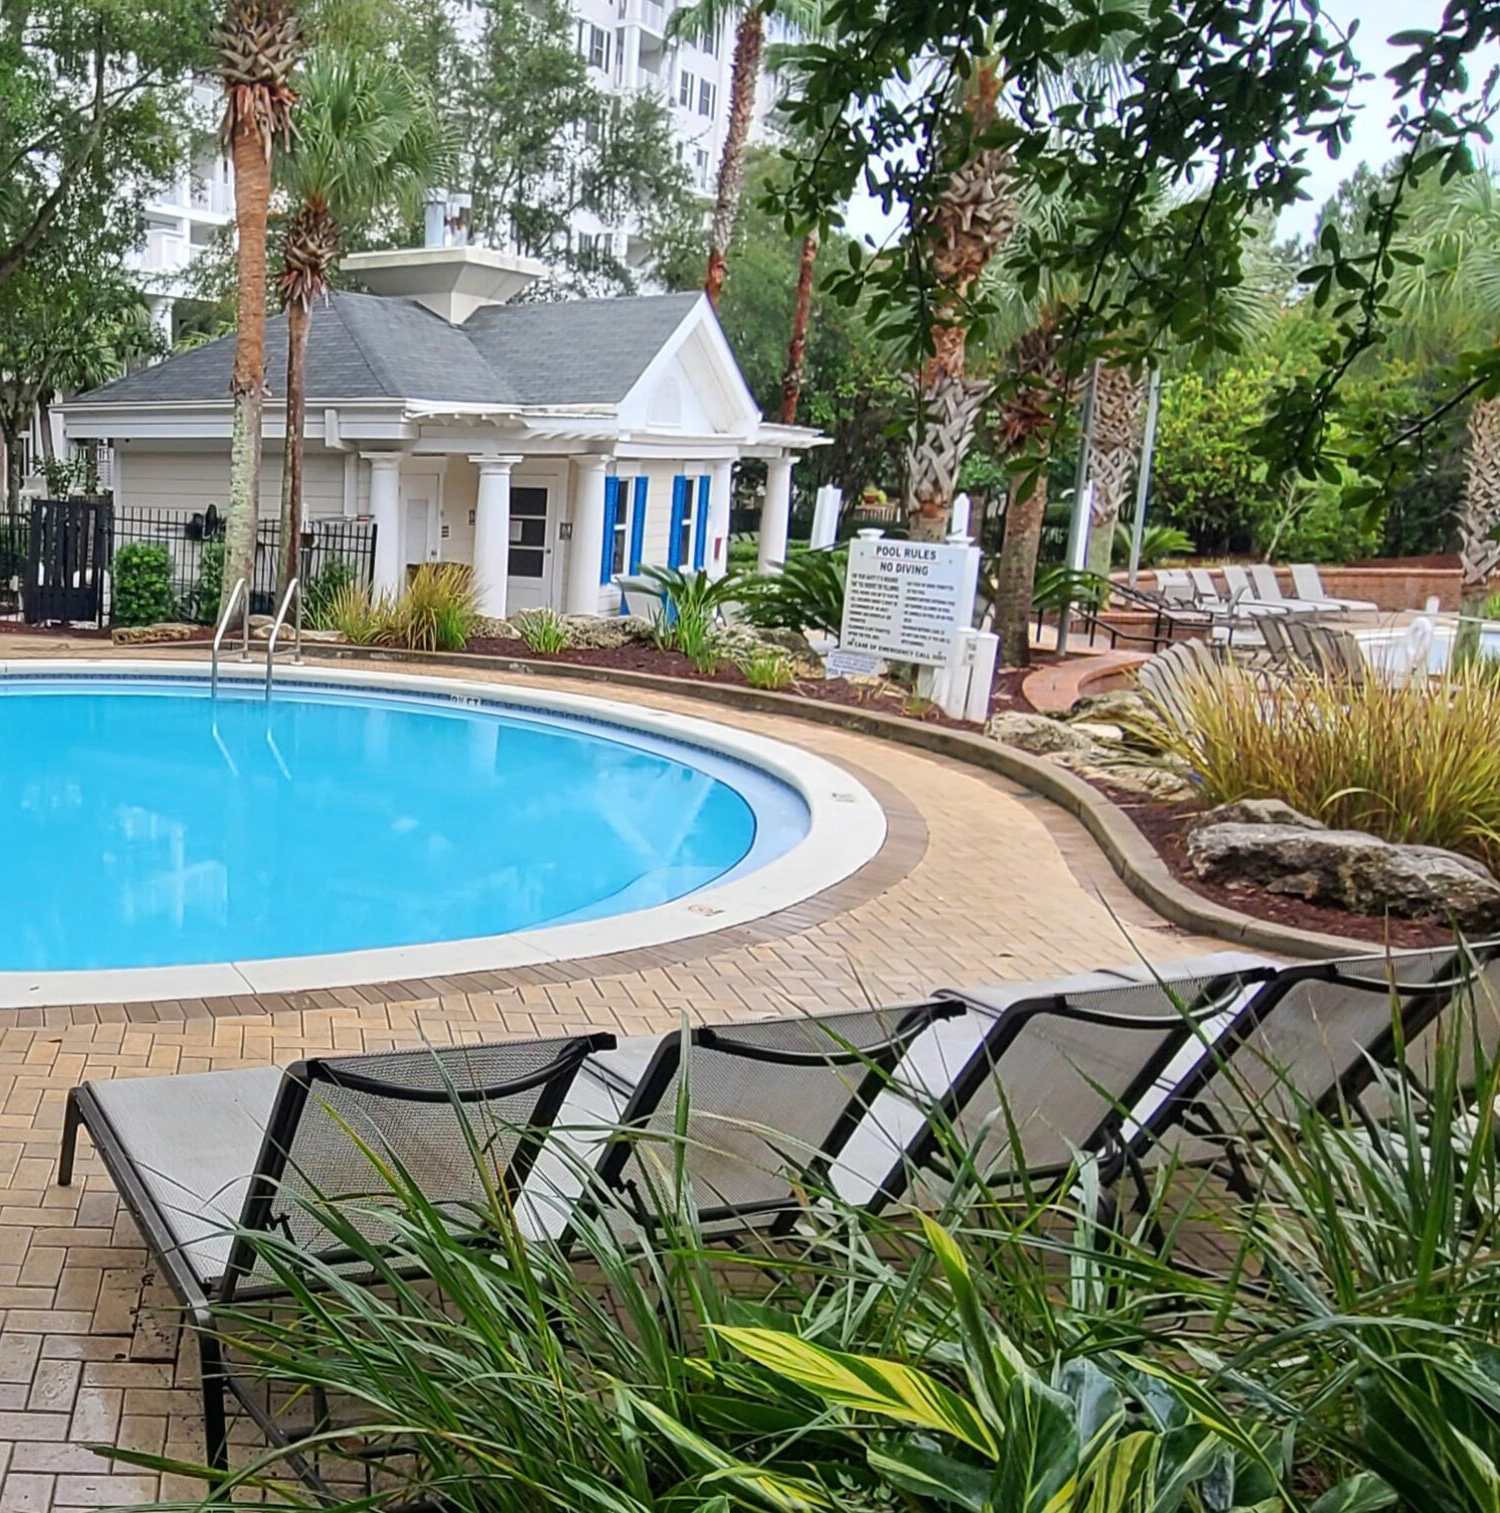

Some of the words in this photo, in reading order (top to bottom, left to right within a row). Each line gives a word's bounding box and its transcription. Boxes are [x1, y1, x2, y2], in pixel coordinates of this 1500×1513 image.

[876, 545, 901, 557] POOL
[904, 548, 937, 560] RULES
[880, 562, 894, 573] NO
[895, 563, 929, 576] DIVING
[878, 645, 914, 657] EMERGENCY
[915, 650, 930, 660] CALL
